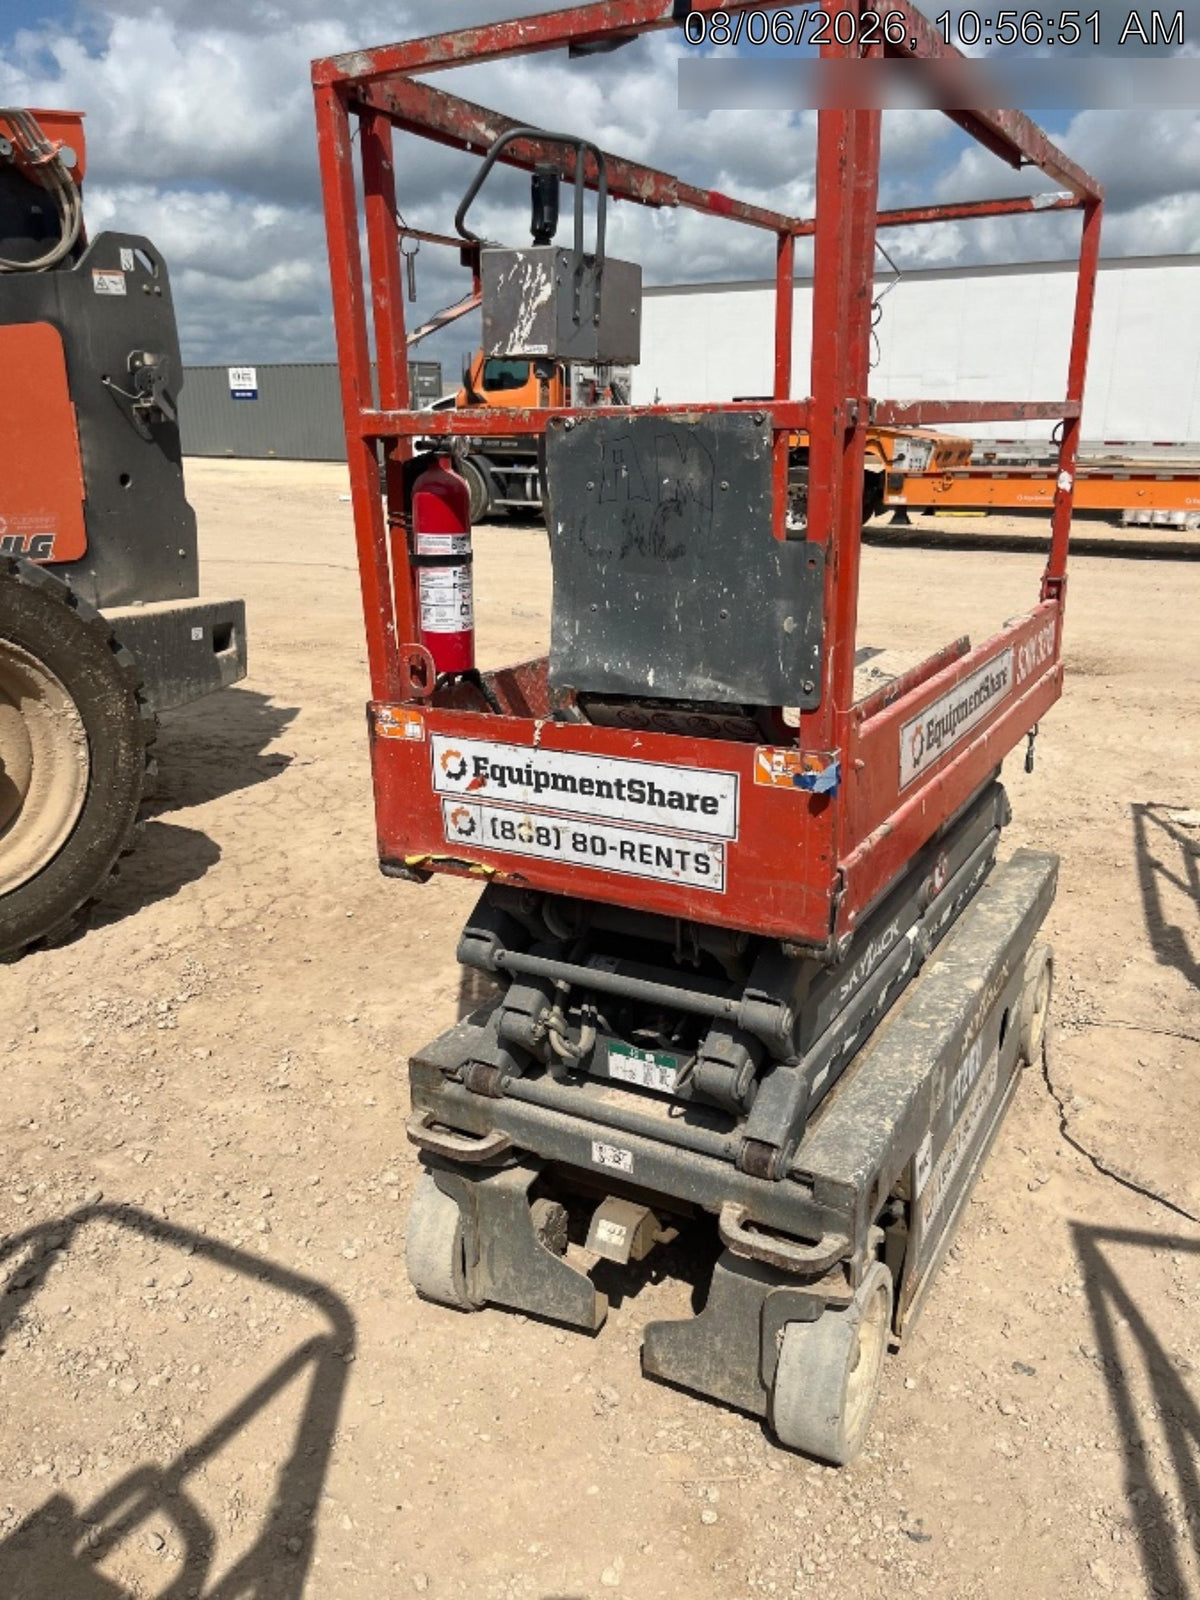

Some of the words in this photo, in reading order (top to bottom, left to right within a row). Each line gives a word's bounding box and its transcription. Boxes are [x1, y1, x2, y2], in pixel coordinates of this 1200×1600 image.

[926, 668, 1008, 751] EquipmentShare
[472, 755, 720, 815] EquipmentShare
[490, 817, 561, 850] (888)
[571, 832, 711, 875] 80-RENTS
